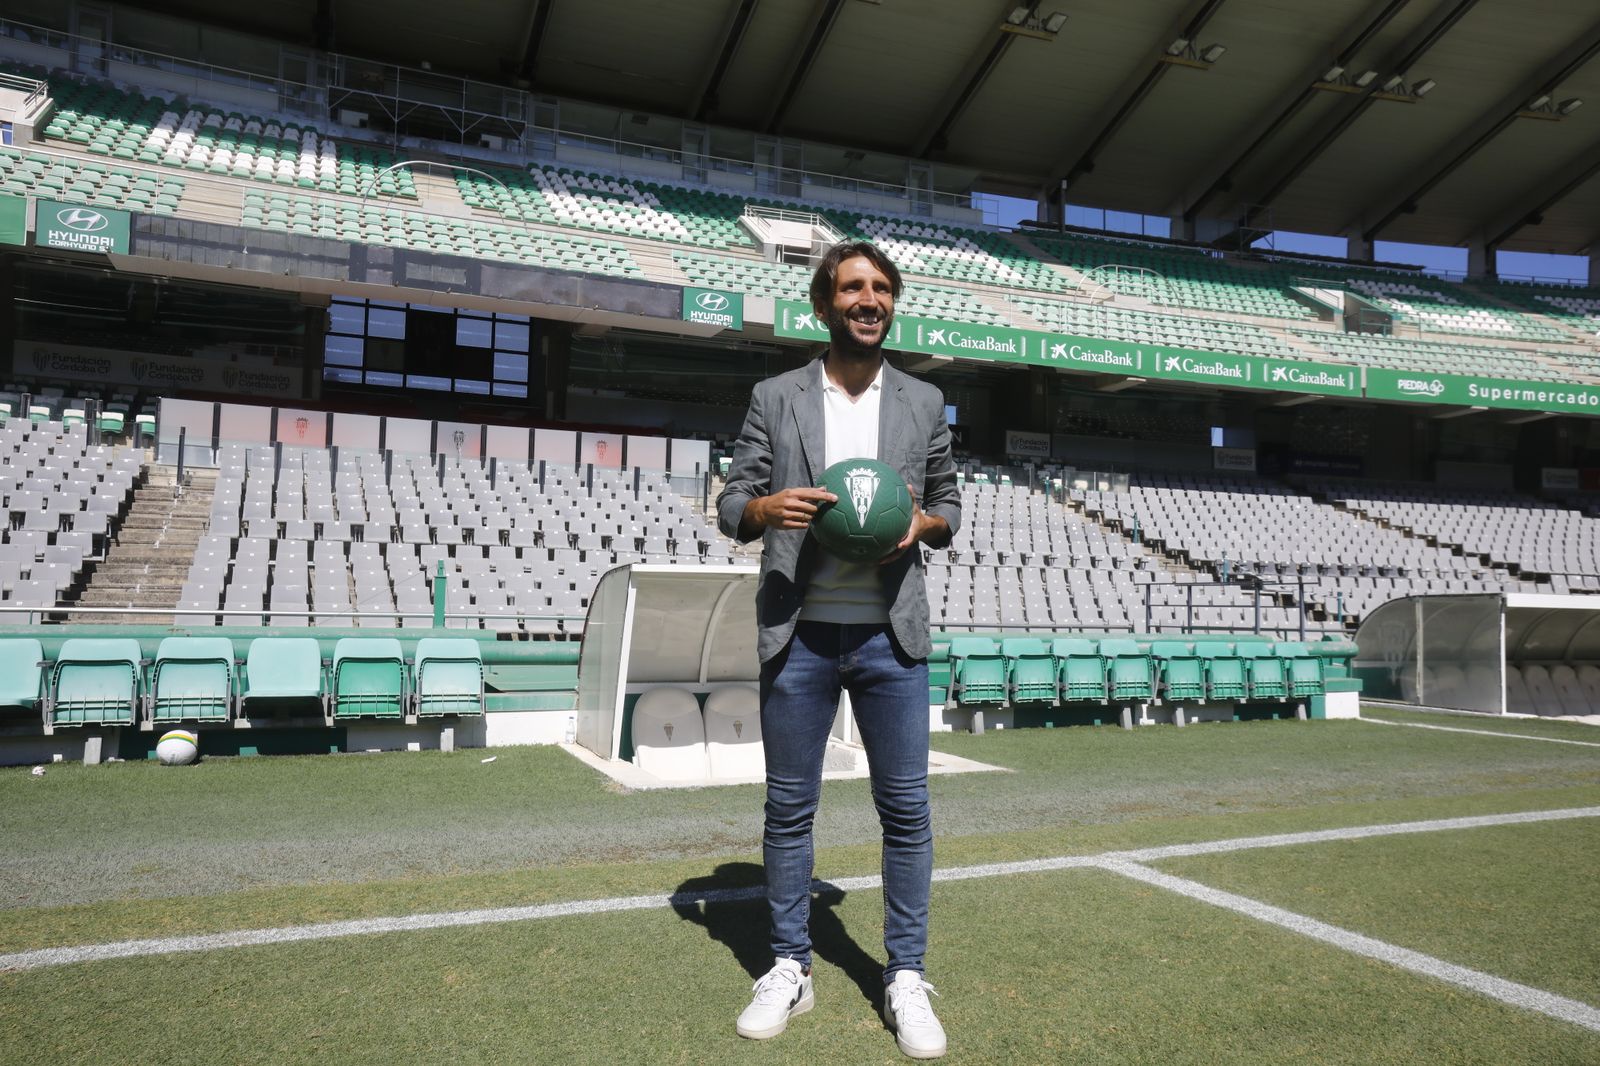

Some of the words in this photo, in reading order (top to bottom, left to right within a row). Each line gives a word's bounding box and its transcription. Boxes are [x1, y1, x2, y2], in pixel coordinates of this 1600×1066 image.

[48, 229, 114, 246] HYUNDAI
[690, 310, 733, 323] HYUNDAI
[948, 331, 1017, 354] CaixaBank
[51, 352, 112, 367] Fundación
[1069, 345, 1133, 367] CaixaBank
[1182, 358, 1243, 378] CaixaBank
[1288, 368, 1346, 387] CaixaBank
[1398, 379, 1429, 391] PIEDRA
[1468, 383, 1599, 406] Supermercado
